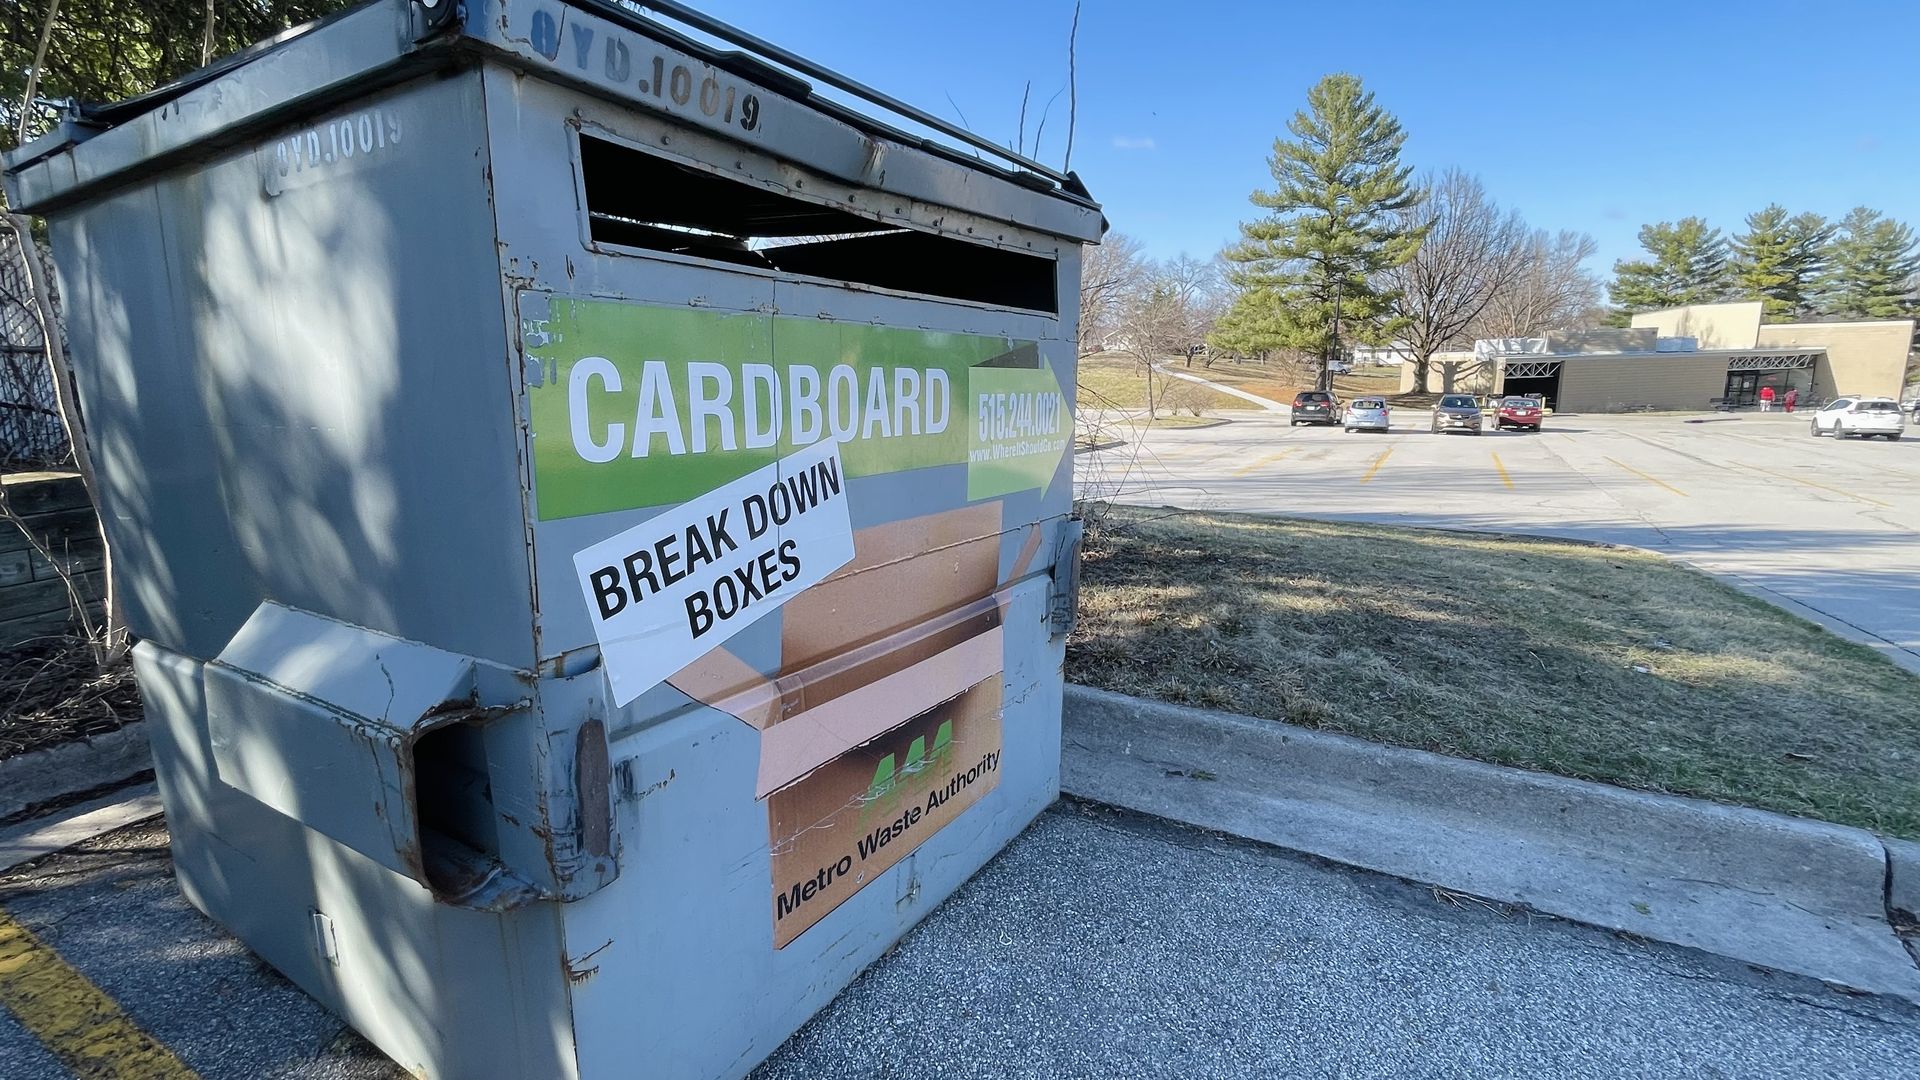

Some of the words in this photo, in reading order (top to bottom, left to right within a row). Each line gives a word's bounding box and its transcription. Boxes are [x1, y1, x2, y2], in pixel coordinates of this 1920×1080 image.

[568, 356, 950, 463] CARDBOARD
[978, 392, 1061, 442] 515.244.0021
[589, 507, 739, 621] BREAK
[742, 456, 841, 541] DOWN
[684, 539, 801, 640] BOXES
[777, 856, 851, 921] Metro
[857, 806, 922, 861] Waste
[925, 749, 1000, 816] Authority
